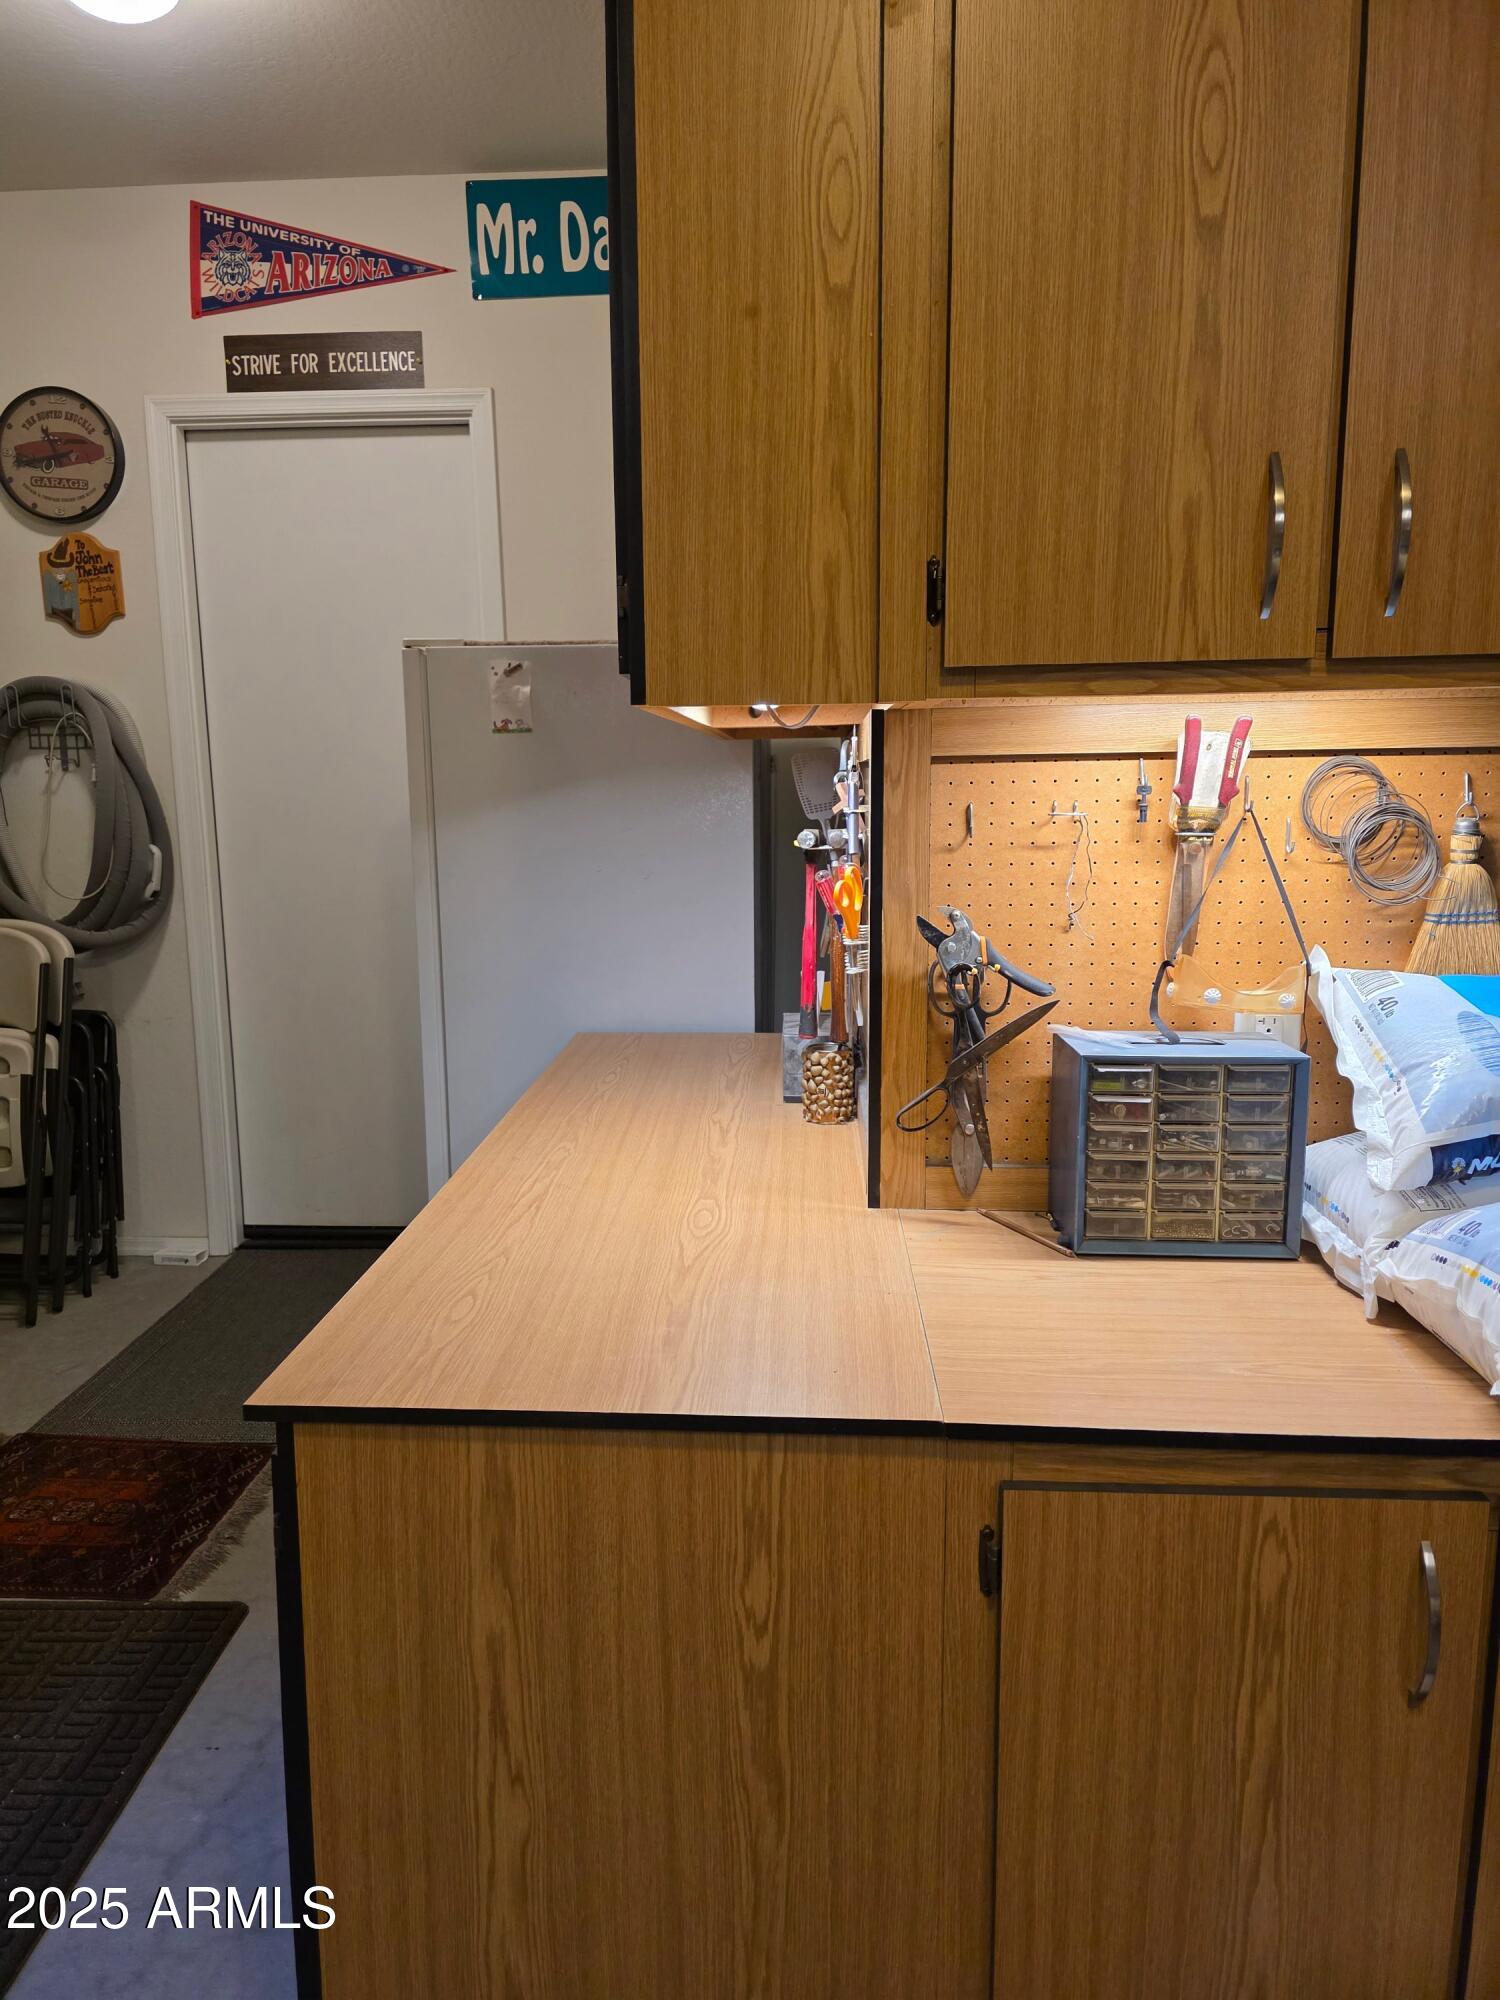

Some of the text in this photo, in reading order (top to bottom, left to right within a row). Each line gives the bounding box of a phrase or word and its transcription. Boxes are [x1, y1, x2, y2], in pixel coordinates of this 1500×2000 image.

[203, 210, 361, 257] THE UNIVERSITY OF
[476, 202, 545, 275] Mr.
[201, 231, 263, 264] ARIZONA
[264, 250, 394, 294] ARIZONA
[202, 267, 265, 302] WILDCATS
[232, 351, 417, 376] STRIVE FOR EXCELLENCE
[21, 415, 37, 431] THE
[32, 477, 88, 489] GARAGE
[75, 540, 86, 550] To
[75, 550, 103, 565] John
[75, 565, 94, 578] The
[1377, 996, 1399, 1011] 40
